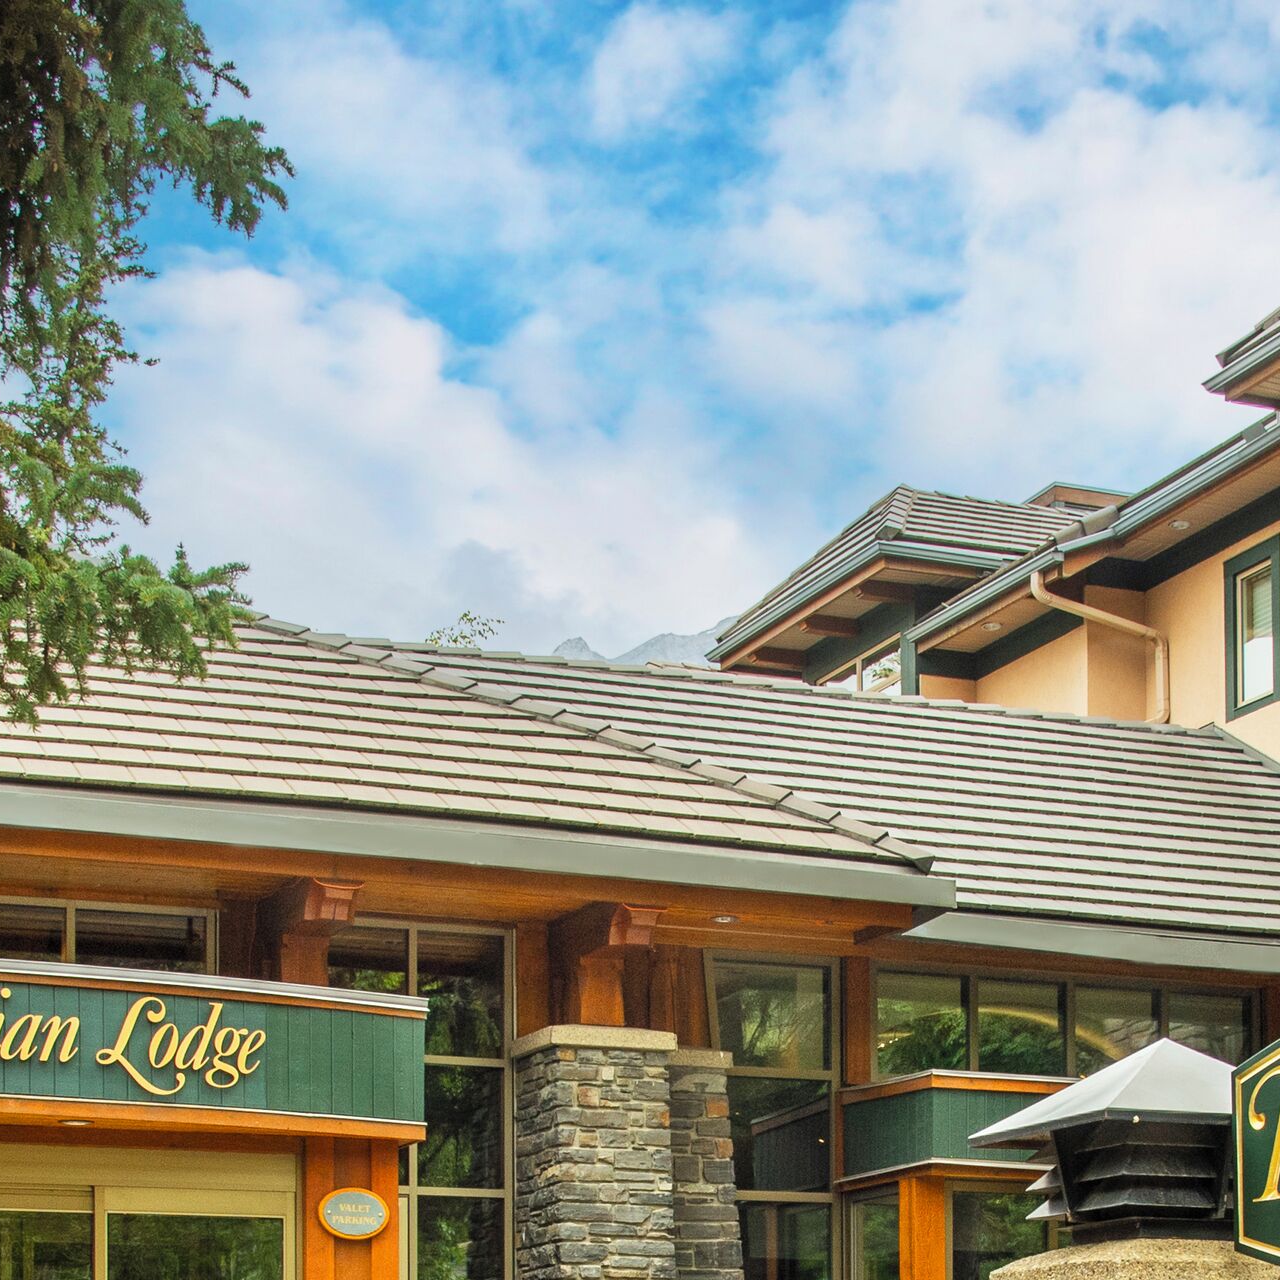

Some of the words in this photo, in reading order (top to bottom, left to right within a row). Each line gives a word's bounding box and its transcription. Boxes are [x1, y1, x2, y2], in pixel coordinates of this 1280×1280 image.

[94, 996, 268, 1097] Lodge
[338, 1203, 371, 1213] VALET
[332, 1215, 377, 1225] PARKING
